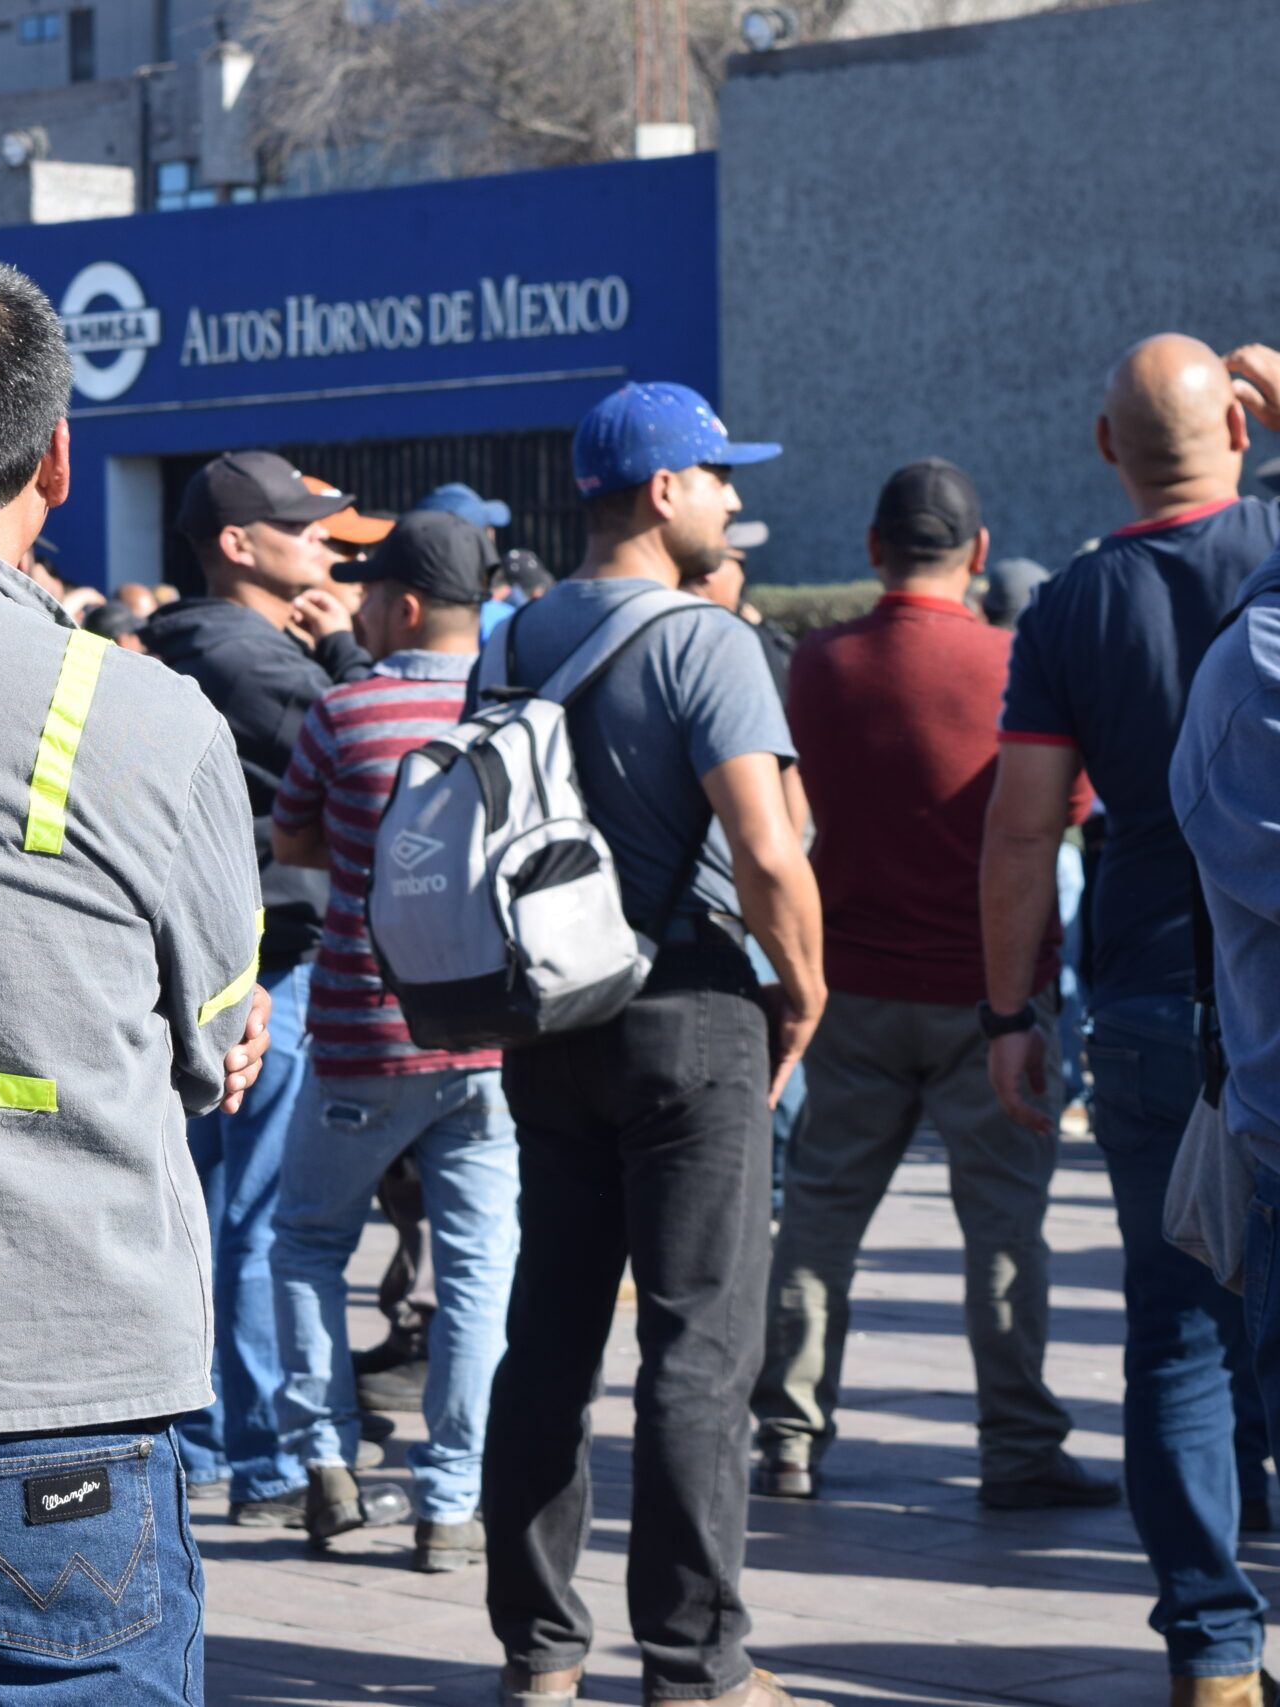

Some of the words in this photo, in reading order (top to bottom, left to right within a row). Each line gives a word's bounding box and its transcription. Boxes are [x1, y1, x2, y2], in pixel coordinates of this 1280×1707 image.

[180, 306, 282, 366] ALTOS
[286, 294, 423, 358] HORNOS
[429, 290, 475, 346] DE
[480, 274, 629, 341] MEXICO
[42, 1481, 100, 1510] Wrangler
